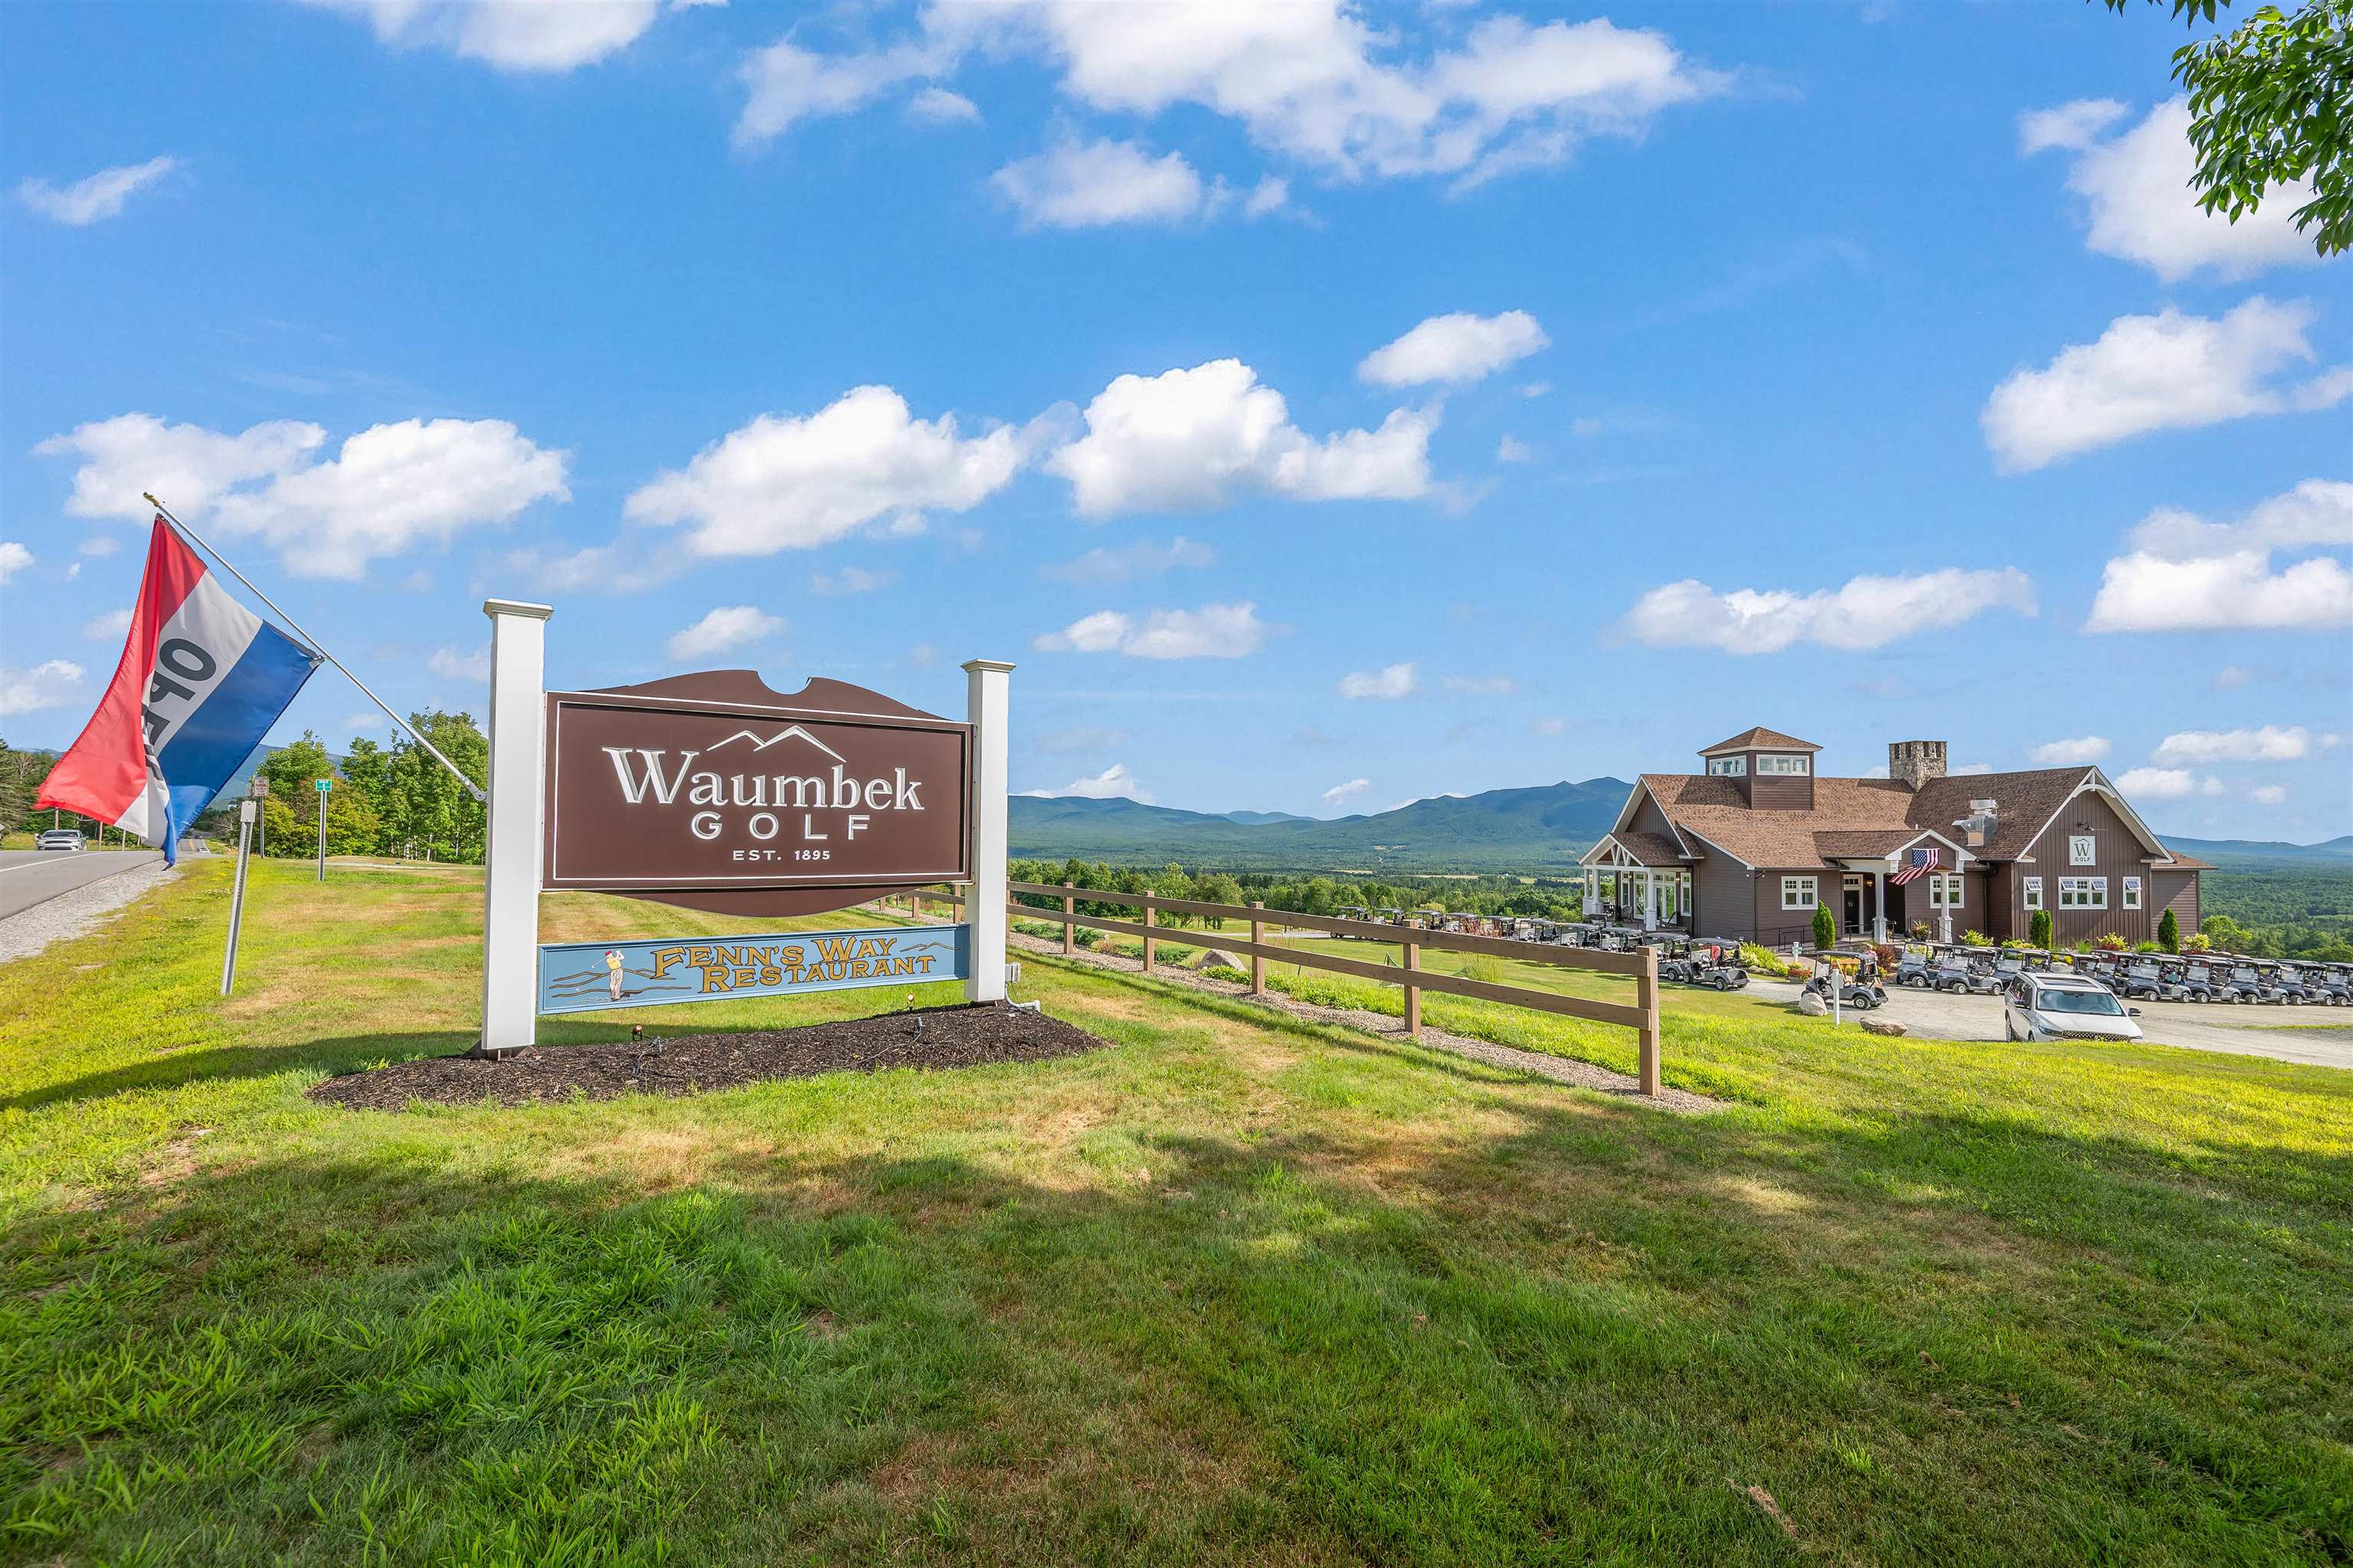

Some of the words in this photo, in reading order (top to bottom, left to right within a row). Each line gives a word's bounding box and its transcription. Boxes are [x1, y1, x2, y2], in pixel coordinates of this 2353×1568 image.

[602, 746, 925, 810] Waumbek
[691, 811, 870, 840] GOLF
[732, 849, 783, 862] EST.
[794, 849, 832, 861] 1895
[2074, 843, 2090, 856] W
[651, 946, 804, 980] FENN'S
[811, 936, 898, 964] WAY
[698, 955, 936, 994] RESTAURANT
